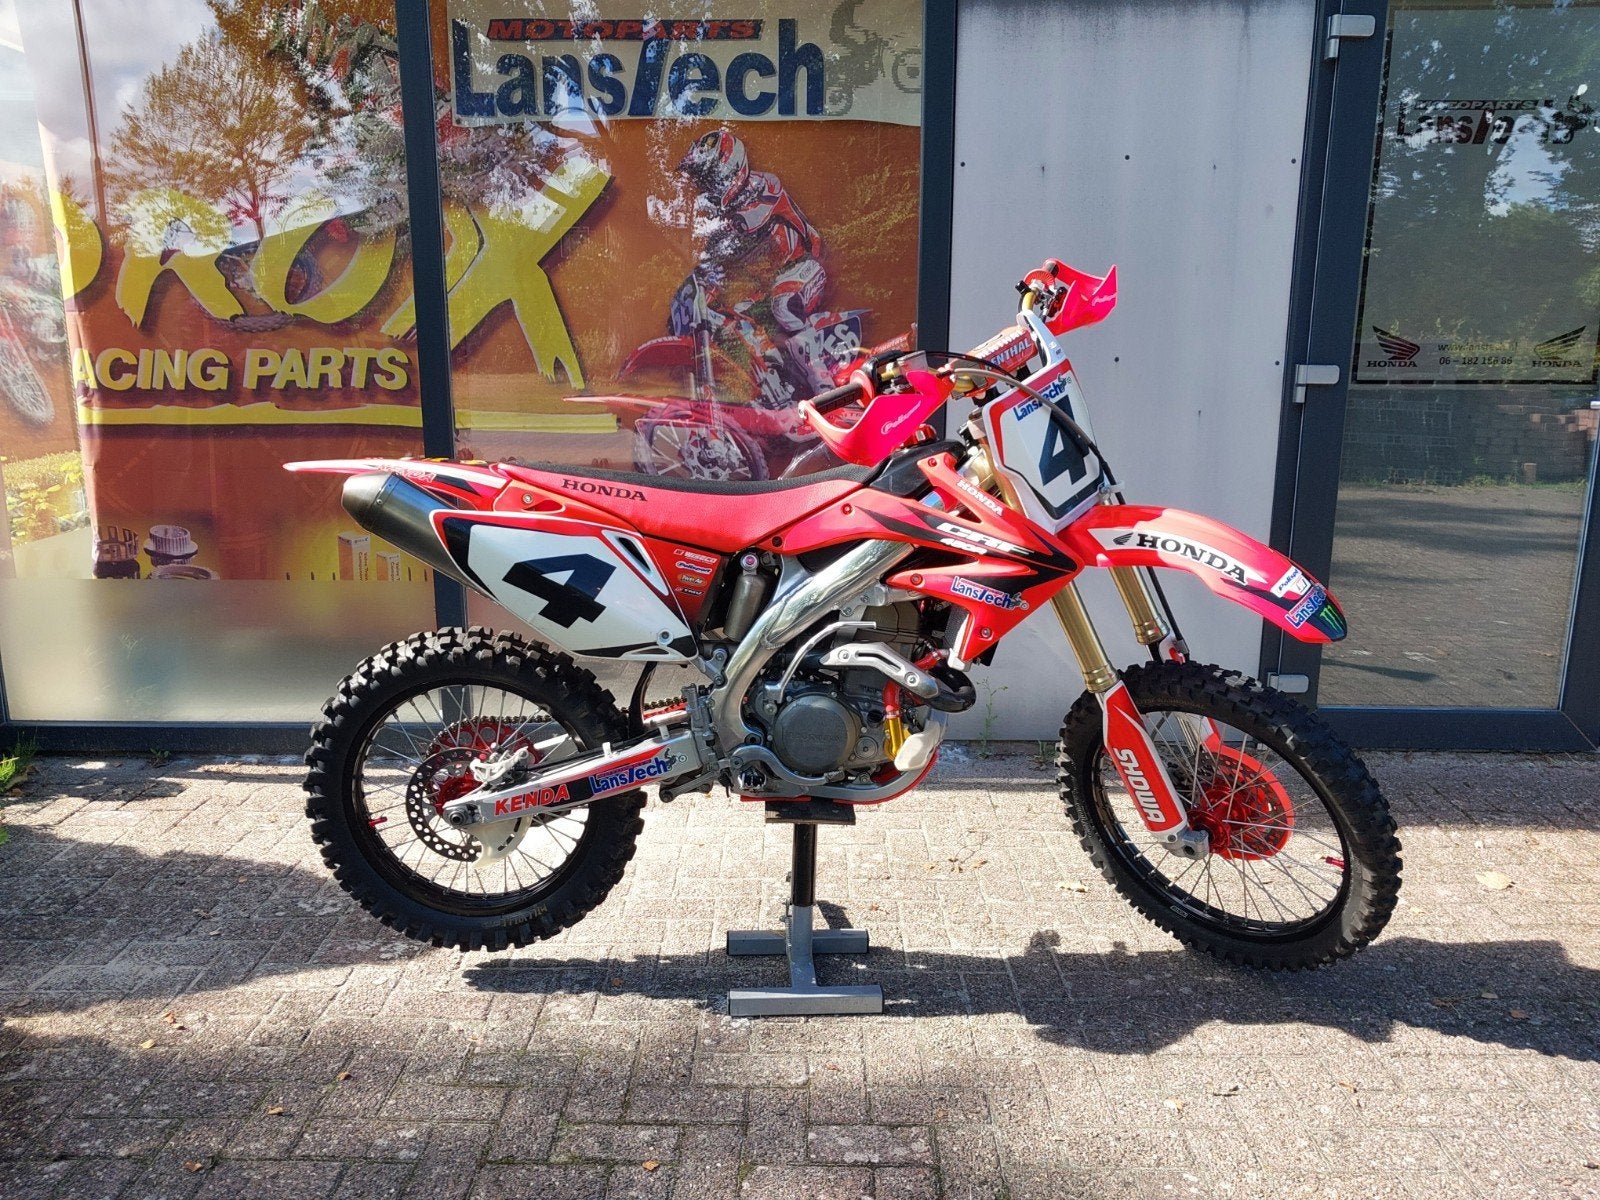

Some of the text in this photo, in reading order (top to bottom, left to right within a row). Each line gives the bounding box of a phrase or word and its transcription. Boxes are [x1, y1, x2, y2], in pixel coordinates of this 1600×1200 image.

[487, 20, 756, 39] MOTOPARTS
[451, 18, 825, 117] LansTech
[1397, 98, 1574, 145] LansTe
[243, 348, 409, 391] PARTS
[1366, 360, 1418, 368] HONDA
[1439, 356, 1450, 365] 06
[1532, 360, 1583, 368] HONDA
[1039, 393, 1089, 487] 4
[561, 478, 649, 502] HONDA
[957, 480, 1003, 516] HONDA
[937, 523, 1035, 555] CRF
[1136, 533, 1248, 585] HONDA
[502, 553, 617, 628] 4
[952, 576, 1012, 609] LansTech
[589, 758, 668, 793] LansTech
[1113, 747, 1166, 823] SHOWA
[494, 785, 570, 816] KENDA
